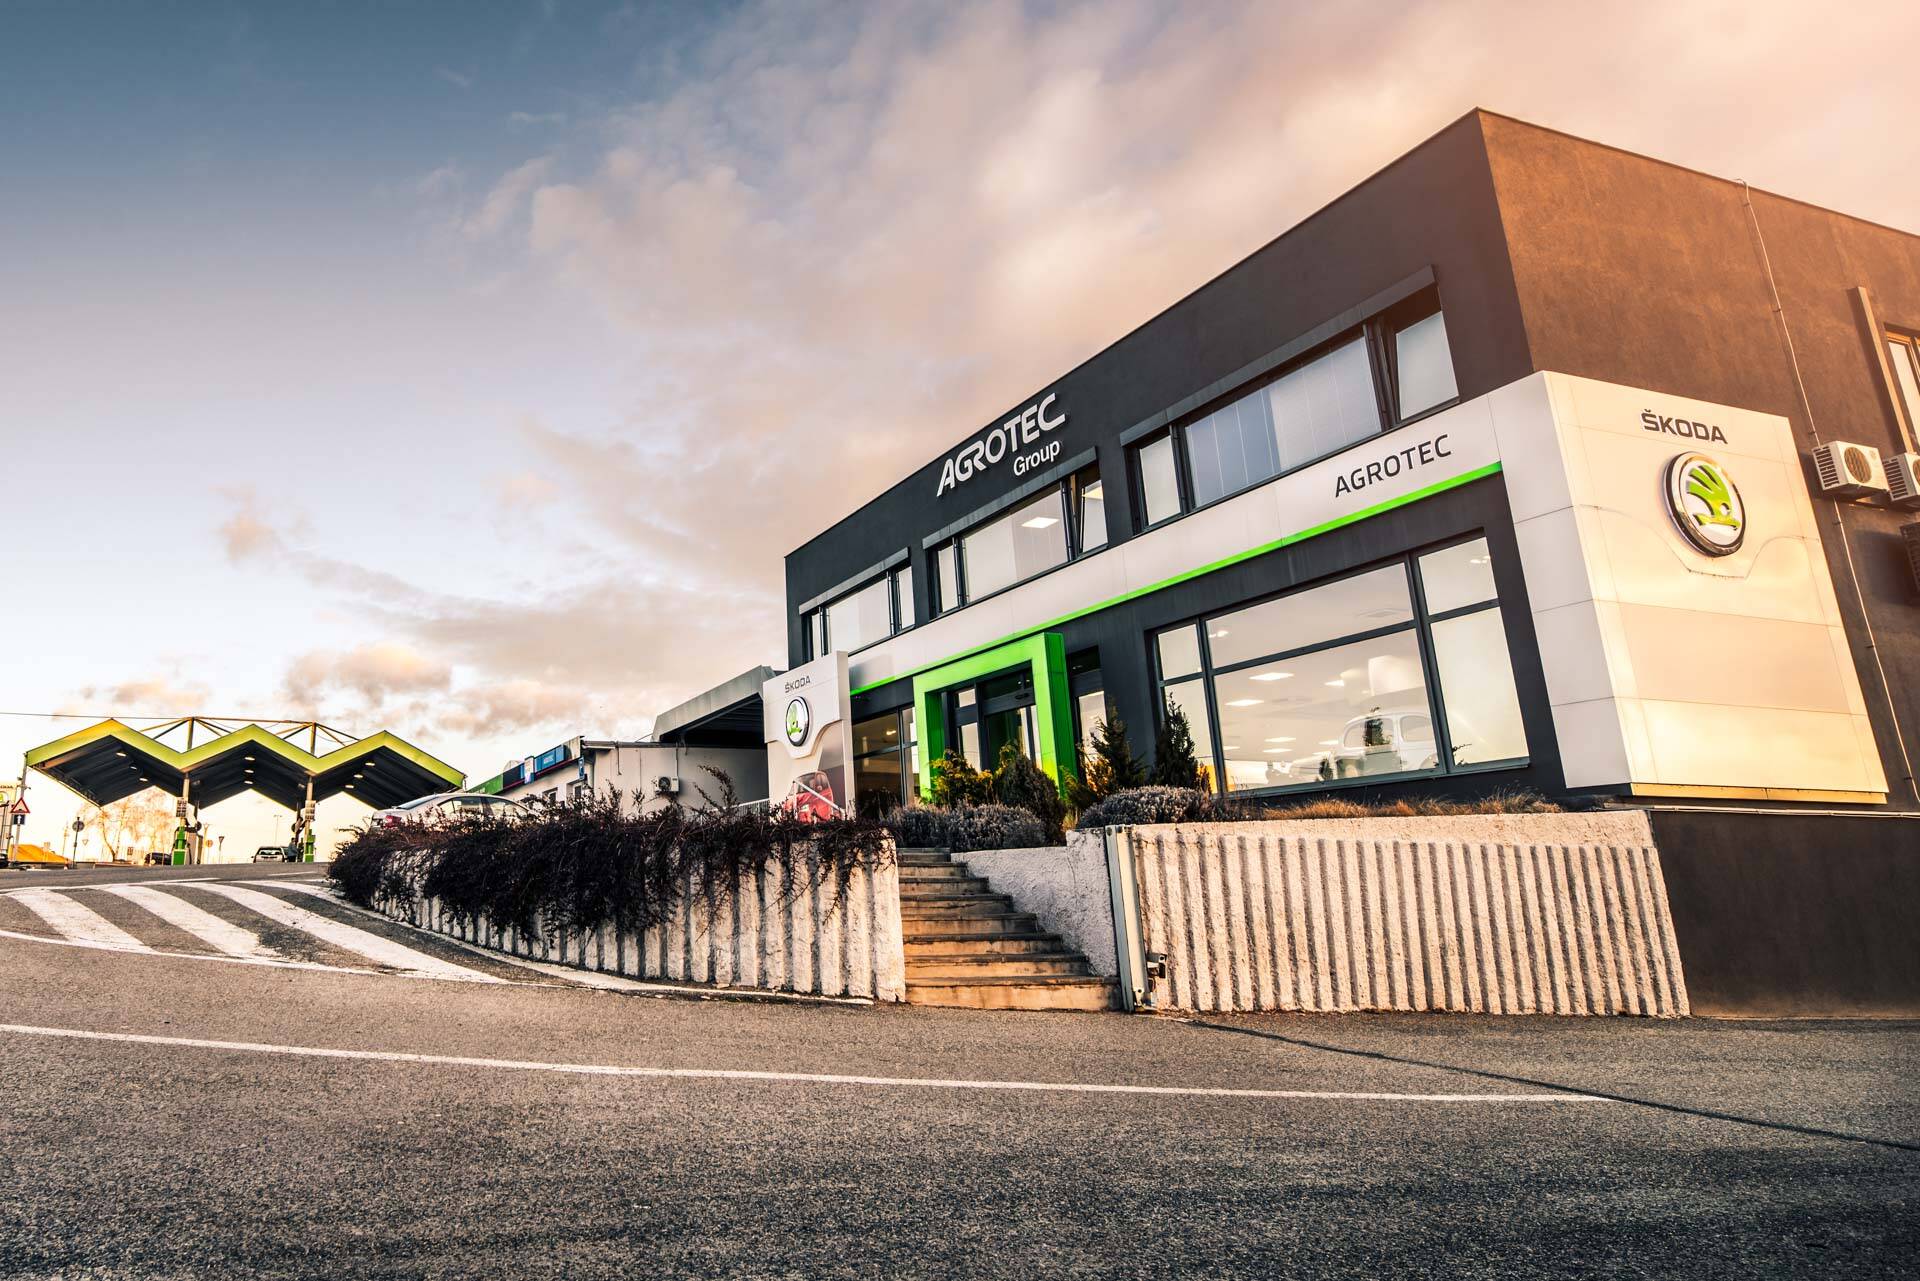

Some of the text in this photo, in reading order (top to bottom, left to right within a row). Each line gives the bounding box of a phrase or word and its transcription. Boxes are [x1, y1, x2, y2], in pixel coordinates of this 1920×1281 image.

[936, 392, 1066, 497] AGROTEC
[1641, 408, 1728, 445] ŠKODA
[1013, 440, 1061, 476] Group
[1335, 433, 1452, 498] AGROTEC
[784, 675, 811, 694] ŠKODA
